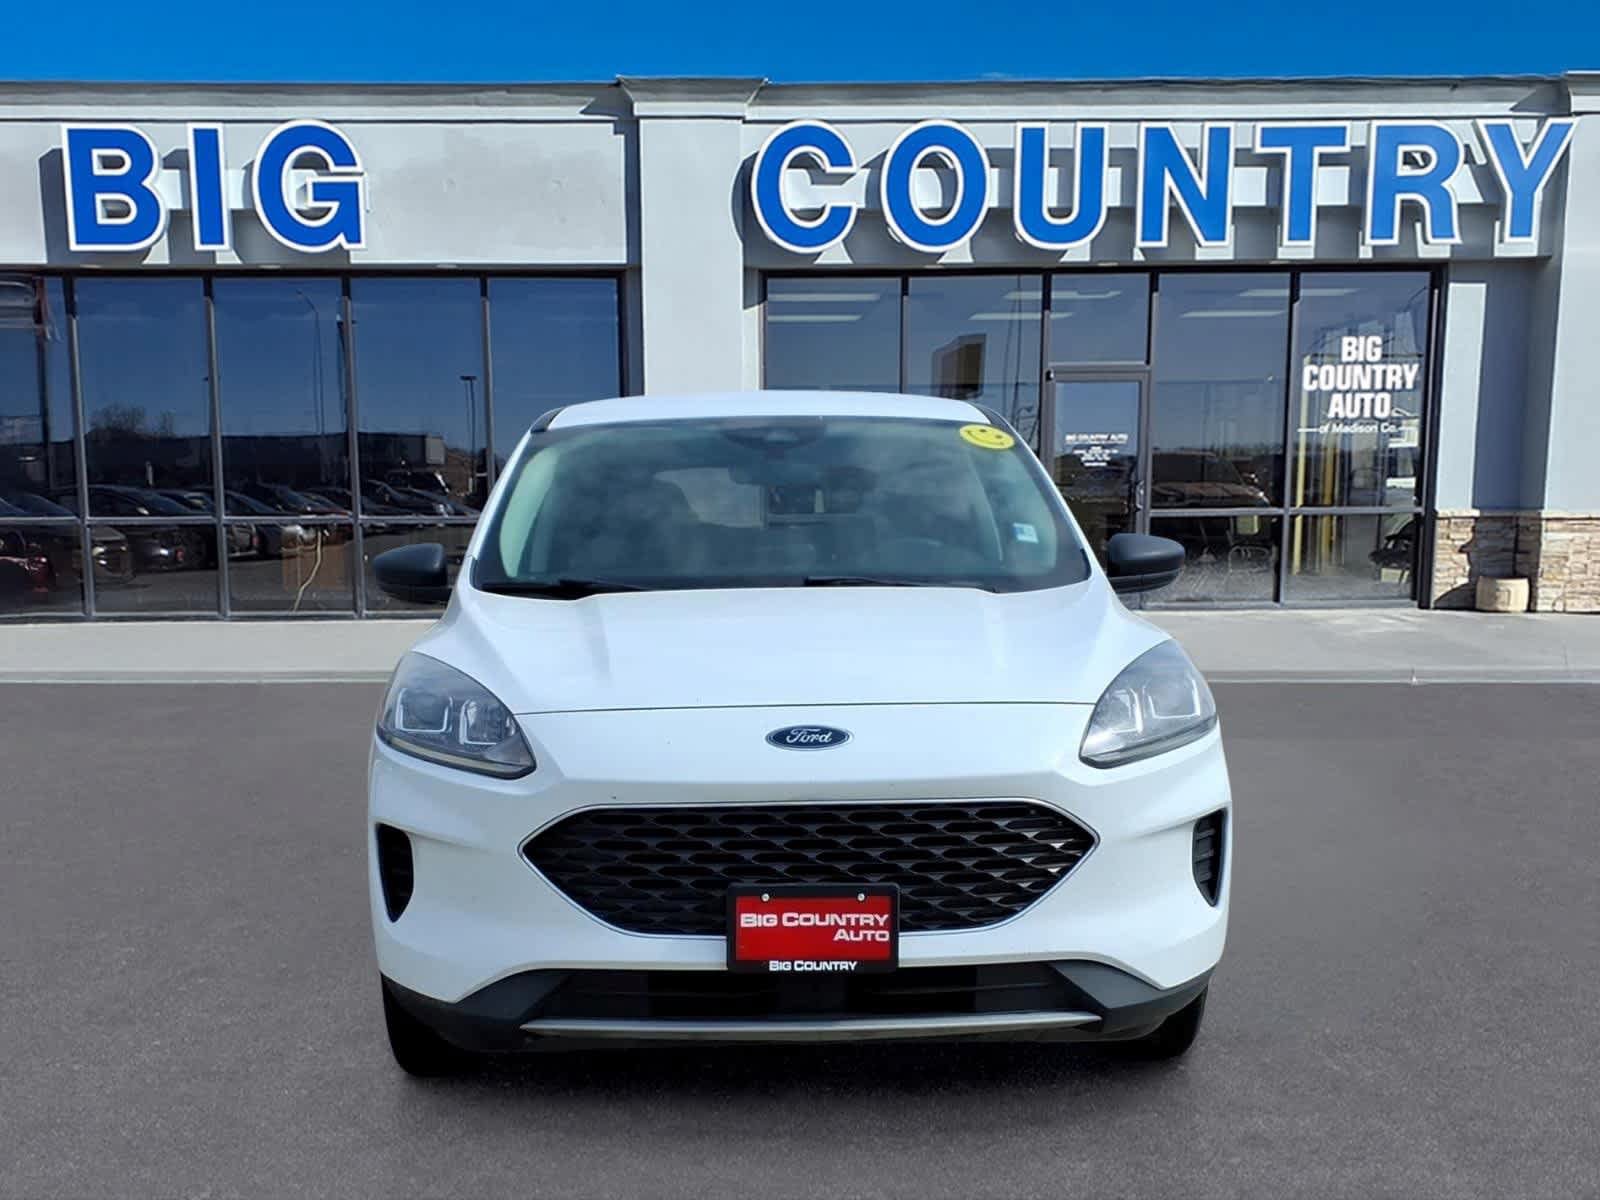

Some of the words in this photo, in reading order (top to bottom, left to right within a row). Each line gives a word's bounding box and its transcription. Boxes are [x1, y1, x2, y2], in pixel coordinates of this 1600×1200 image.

[61, 119, 367, 253] BIG
[749, 118, 1578, 254] COUNTRY
[1341, 335, 1382, 363] BIG
[1302, 363, 1420, 392] COUNTRY
[1327, 392, 1392, 419] AUTO
[1319, 420, 1331, 434] of
[786, 728, 832, 744] Ford
[740, 912, 778, 928] BIG
[782, 912, 889, 927] COUNTRY
[833, 928, 890, 942] AUTO
[769, 960, 792, 972] BIG
[793, 960, 858, 972] COUNTRY
